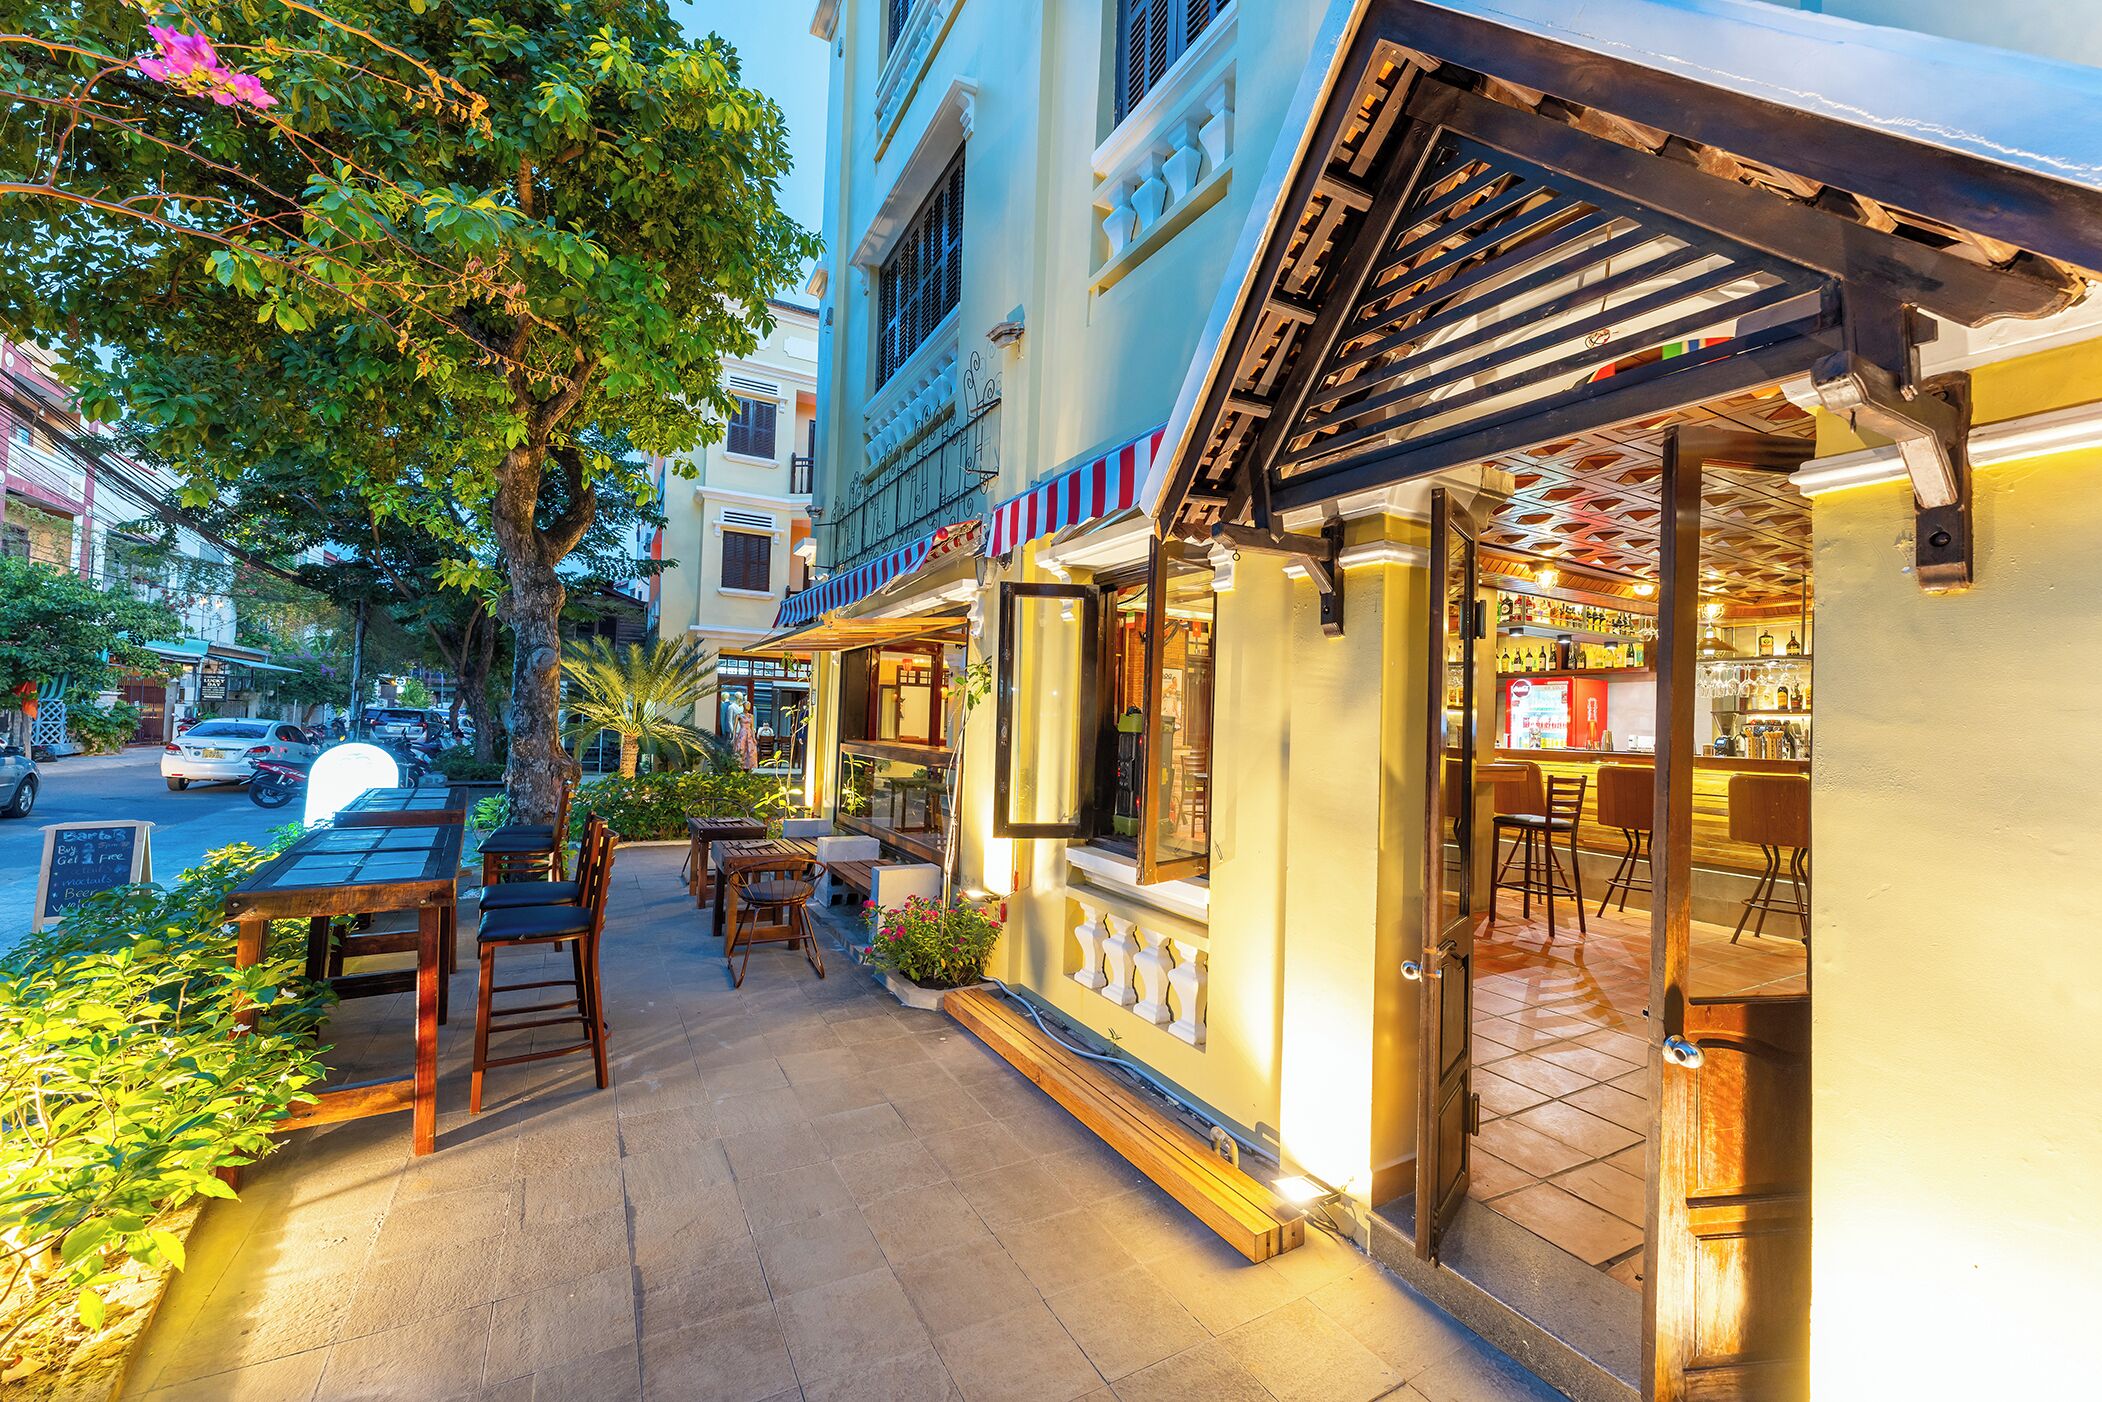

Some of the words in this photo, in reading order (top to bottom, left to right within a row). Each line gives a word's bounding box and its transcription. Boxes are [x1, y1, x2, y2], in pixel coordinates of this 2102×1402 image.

[58, 845, 77, 856] Buy
[99, 853, 126, 864] Free
[64, 887, 98, 900] Beer
